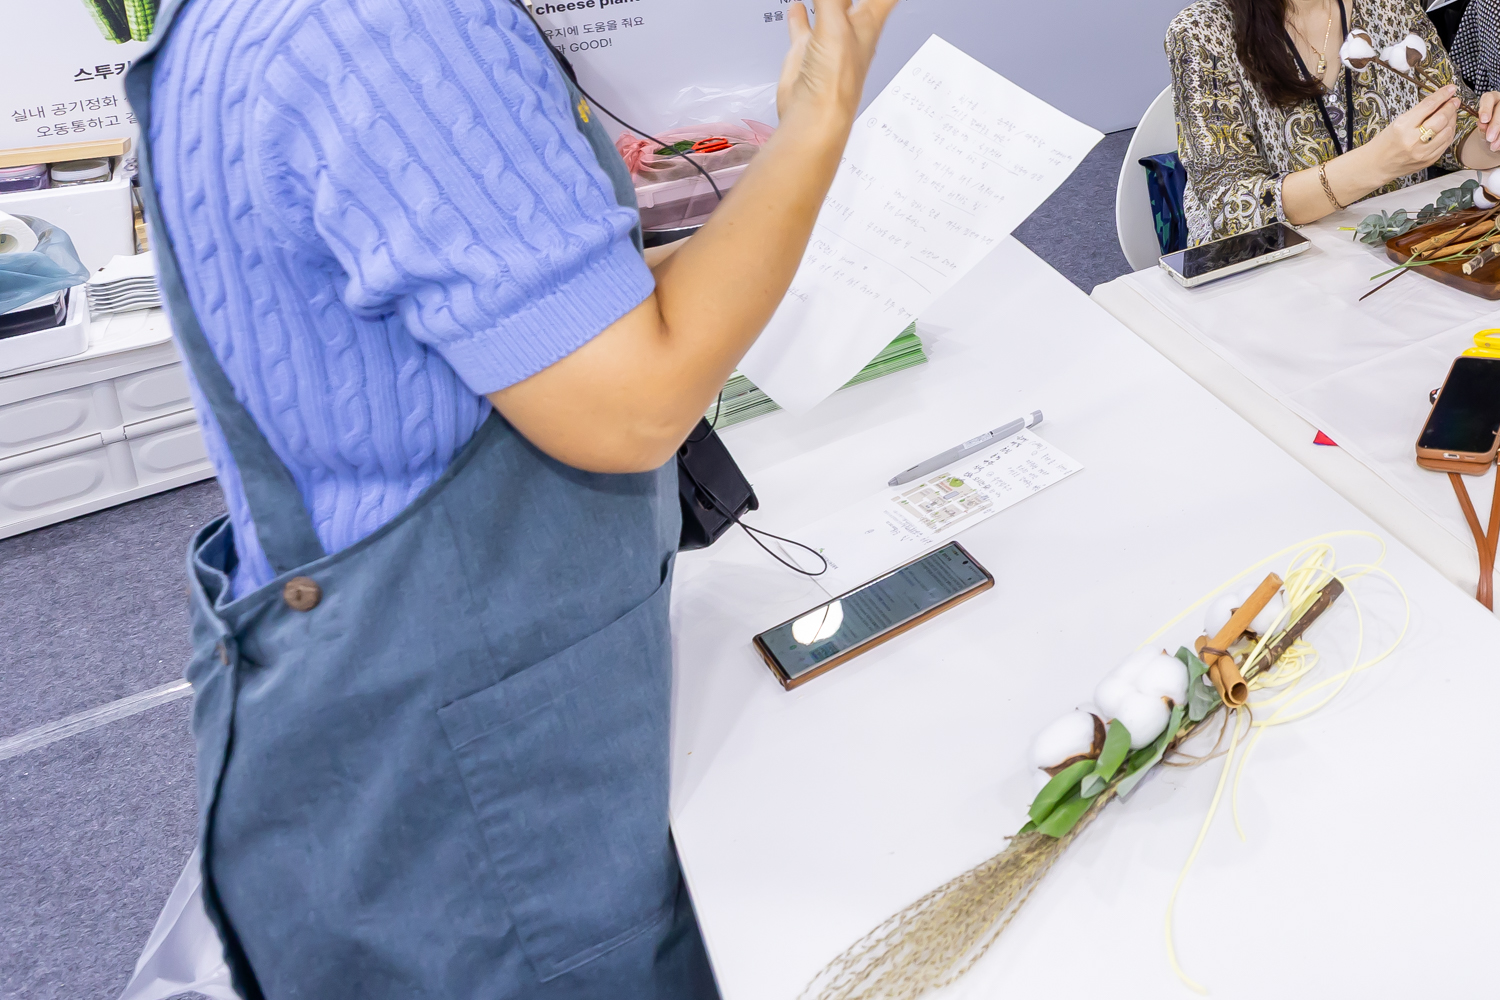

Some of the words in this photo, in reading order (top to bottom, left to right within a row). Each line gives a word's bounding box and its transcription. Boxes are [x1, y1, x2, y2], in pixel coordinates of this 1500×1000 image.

[582, 19, 618, 34] 도움을
[621, 16, 645, 28] 줘요
[569, 37, 613, 53] GOOD!
[11, 105, 46, 122] 실내
[51, 94, 119, 117] 공기정화
[37, 115, 121, 138] 오동통하고
